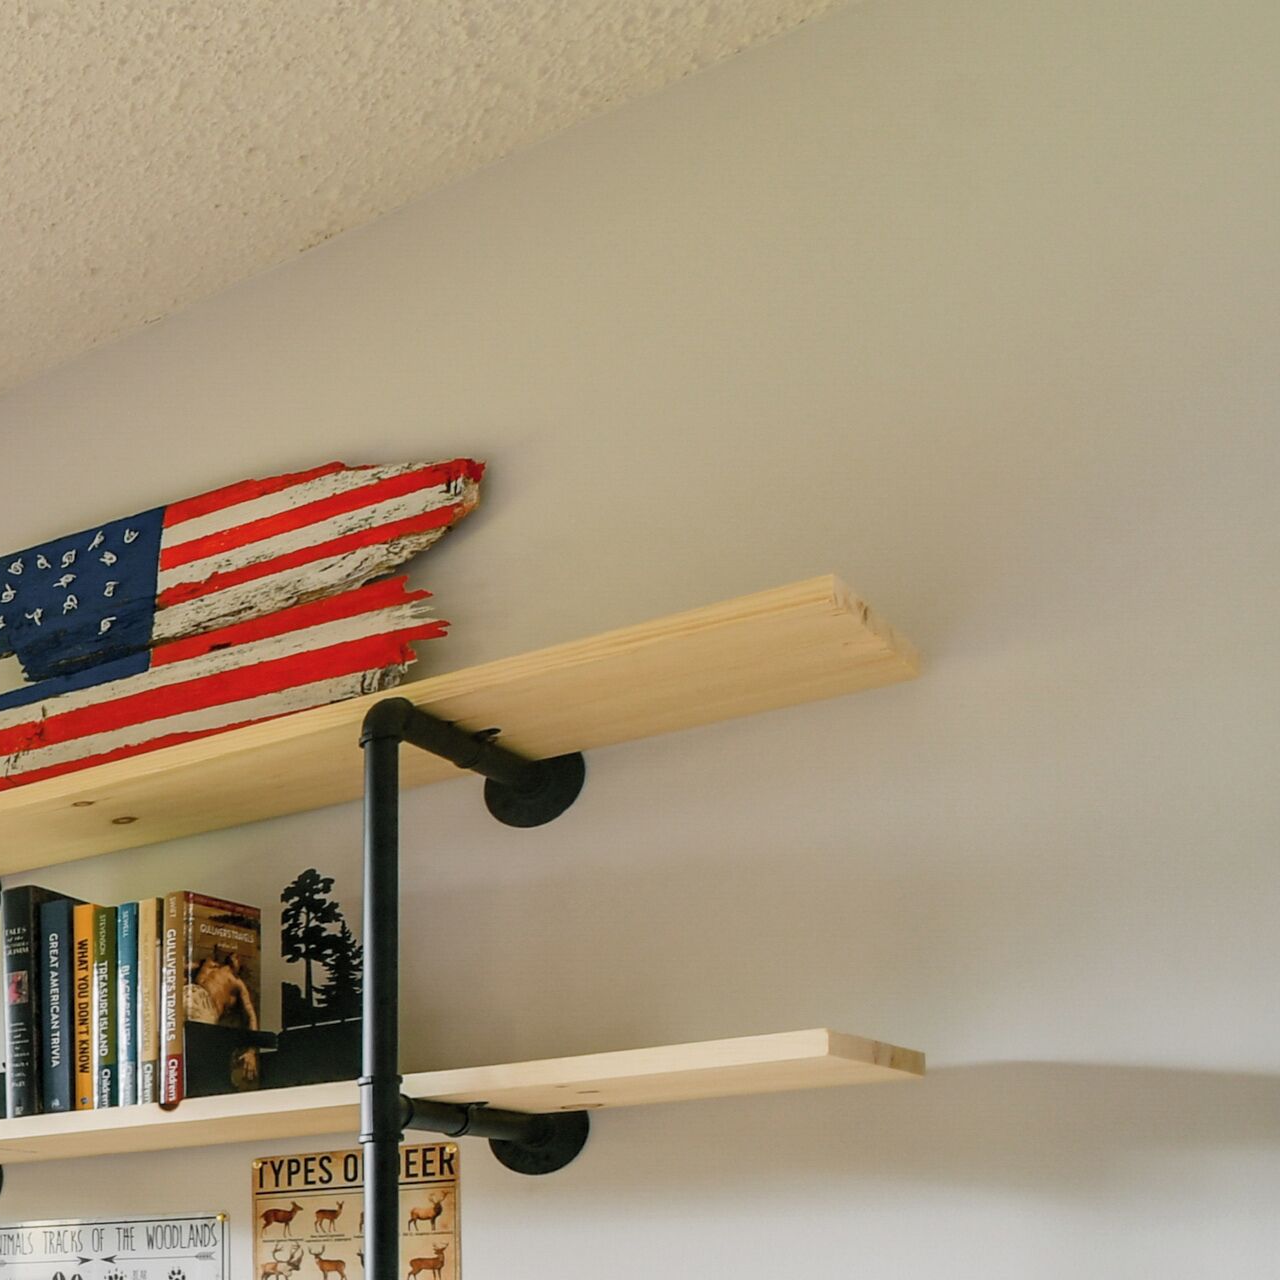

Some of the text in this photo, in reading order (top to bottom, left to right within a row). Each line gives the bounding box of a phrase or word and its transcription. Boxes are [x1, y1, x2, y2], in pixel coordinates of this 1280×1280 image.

[99, 914, 107, 955] STEVENSON
[49, 933, 61, 1068] GREAT AMERICAN TRIVIA
[166, 928, 177, 1041] GULLIVER'S TRAVELS
[77, 939, 90, 1074] WHAT YOU DON'T KNOW
[98, 960, 109, 1056] TREASURE ISLAND
[101, 1068, 111, 1109] Children
[143, 1063, 153, 1104] Children
[259, 1155, 333, 1189] TYPES
[398, 1146, 455, 1179] EER
[42, 1228, 84, 1254] TRACKS
[91, 1227, 105, 1253] OF
[115, 1226, 136, 1252] THE
[146, 1222, 218, 1250] WOODLANDS
